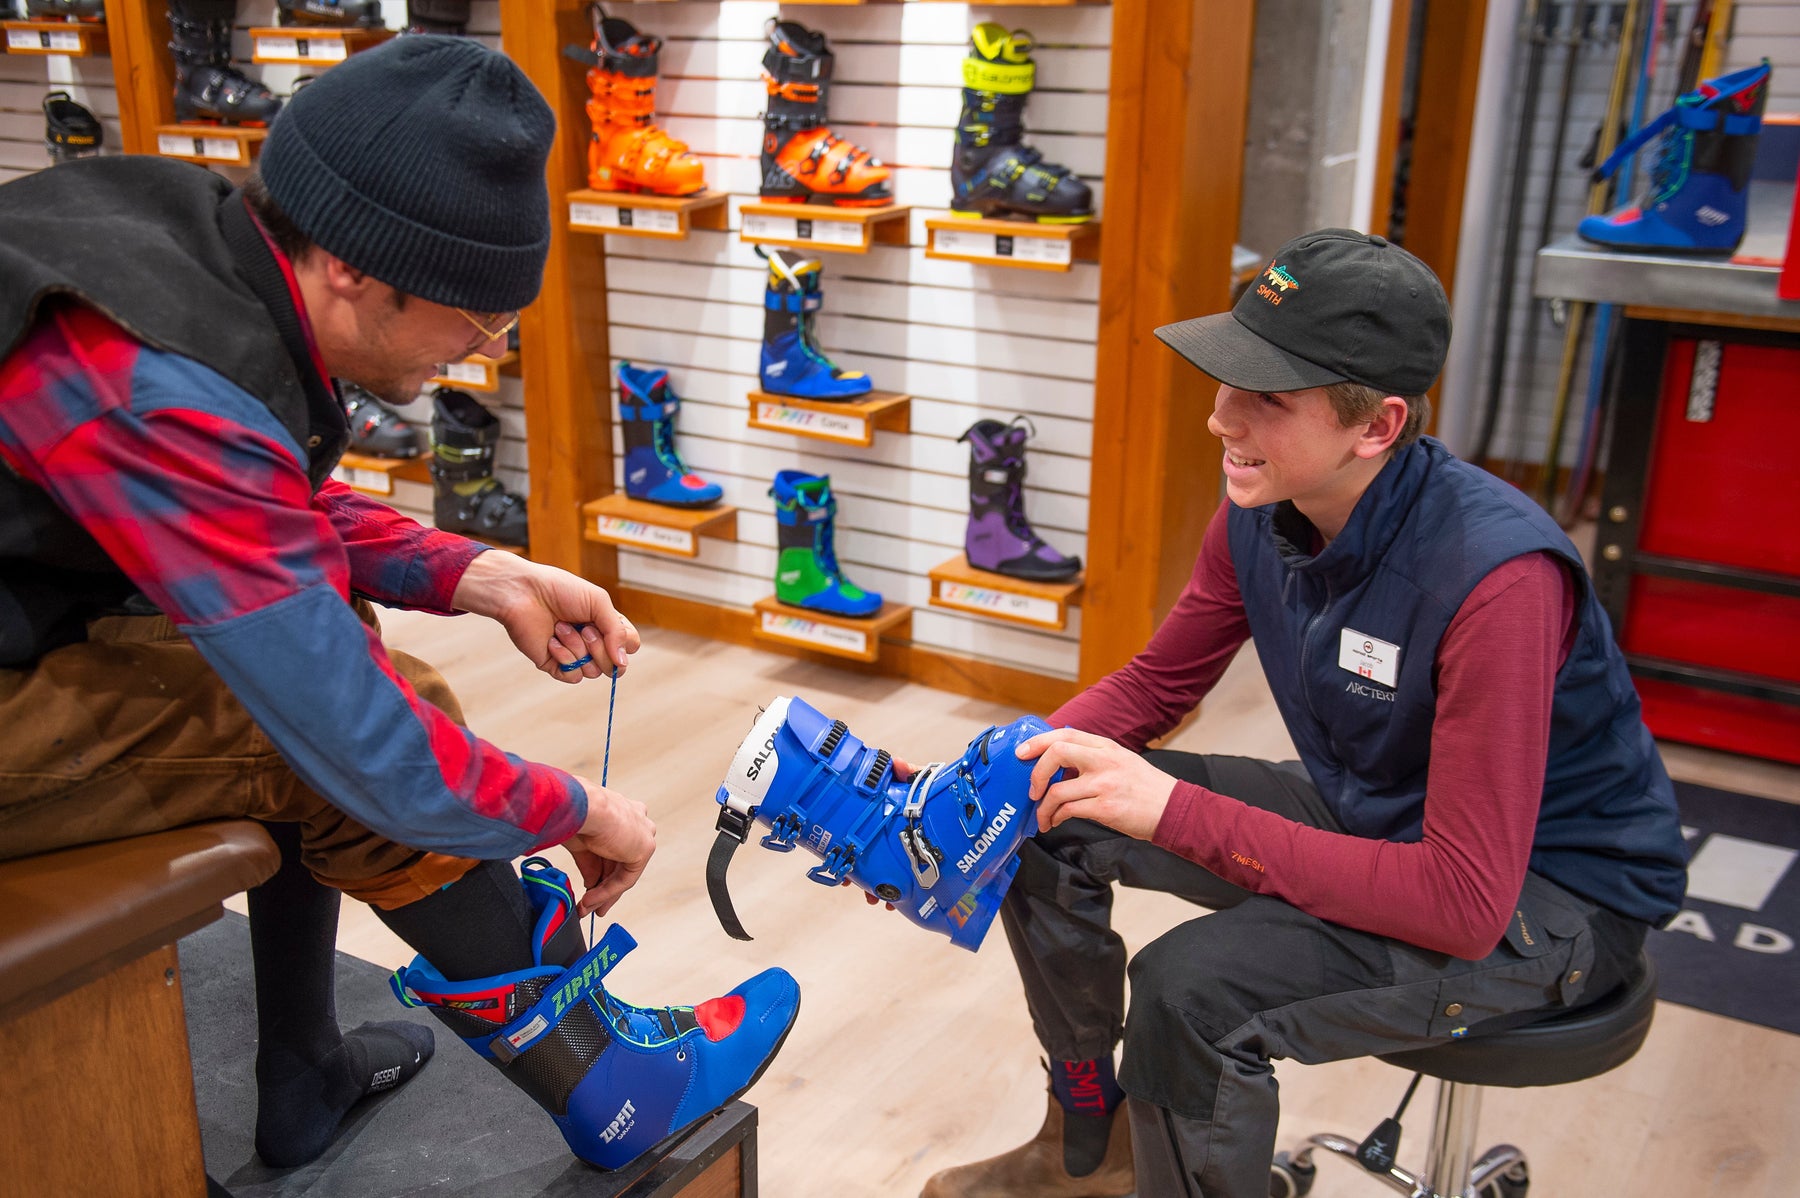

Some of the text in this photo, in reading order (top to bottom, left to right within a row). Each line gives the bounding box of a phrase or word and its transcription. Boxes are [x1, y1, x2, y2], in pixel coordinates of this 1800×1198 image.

[1257, 285, 1283, 306] SMITH
[1345, 681, 1397, 702] ARC'TERY
[746, 726, 780, 781] SALO
[807, 824, 825, 851] PRO
[956, 802, 1017, 874] SALOMON
[1231, 850, 1265, 873] 7MESH
[552, 945, 611, 1018] ZIPFIT
[370, 1065, 401, 1087] DISSENT
[1064, 1059, 1106, 1117] SMIT
[599, 1098, 636, 1144] ZIPFIT
